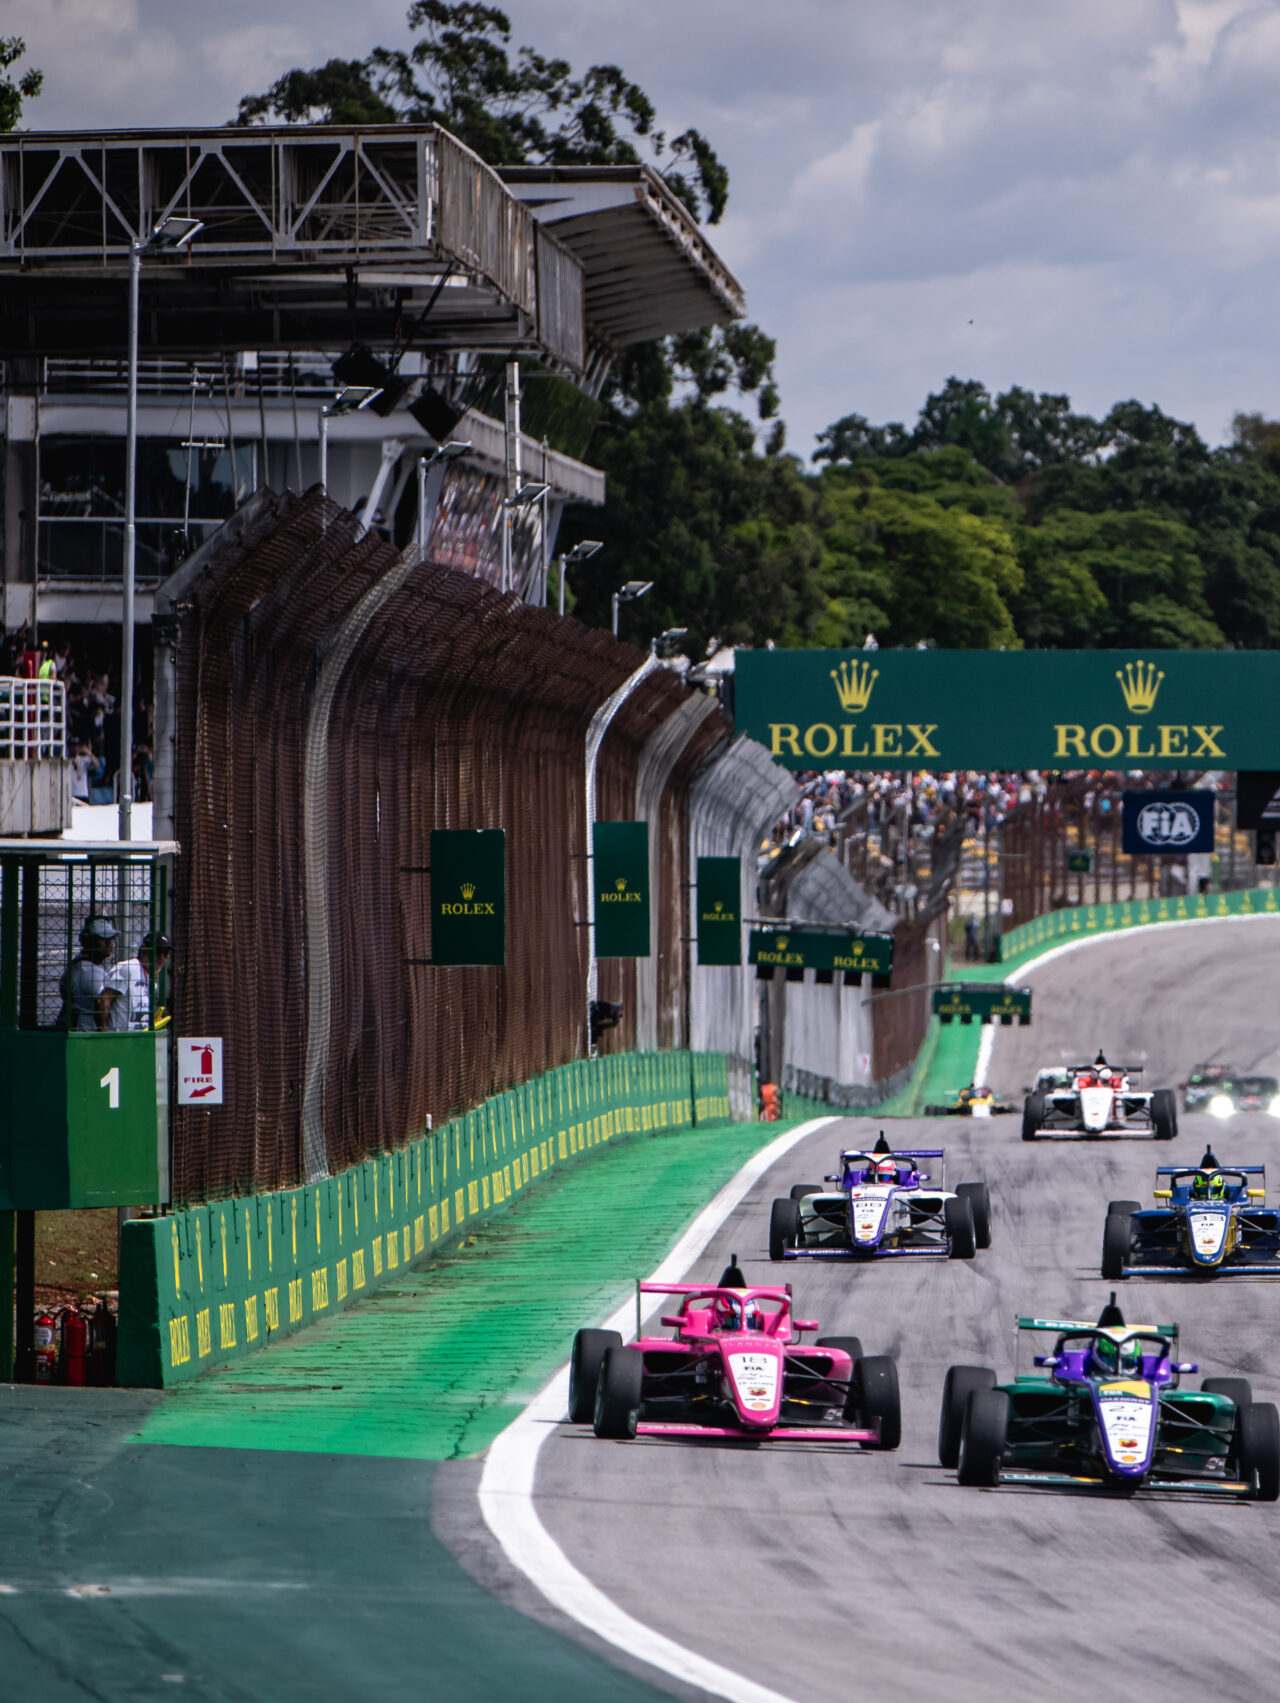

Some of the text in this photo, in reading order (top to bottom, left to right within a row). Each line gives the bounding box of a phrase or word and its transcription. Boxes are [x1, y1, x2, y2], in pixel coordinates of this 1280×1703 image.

[768, 722, 940, 757] ROLEX
[1054, 723, 1226, 758] ROLEX
[601, 892, 641, 902] ROLEX
[441, 903, 495, 915] ROLEX
[702, 912, 734, 921] ROLEX
[757, 951, 804, 965] ROLEX
[833, 954, 880, 969] ROLEX
[100, 1067, 119, 1109] 1
